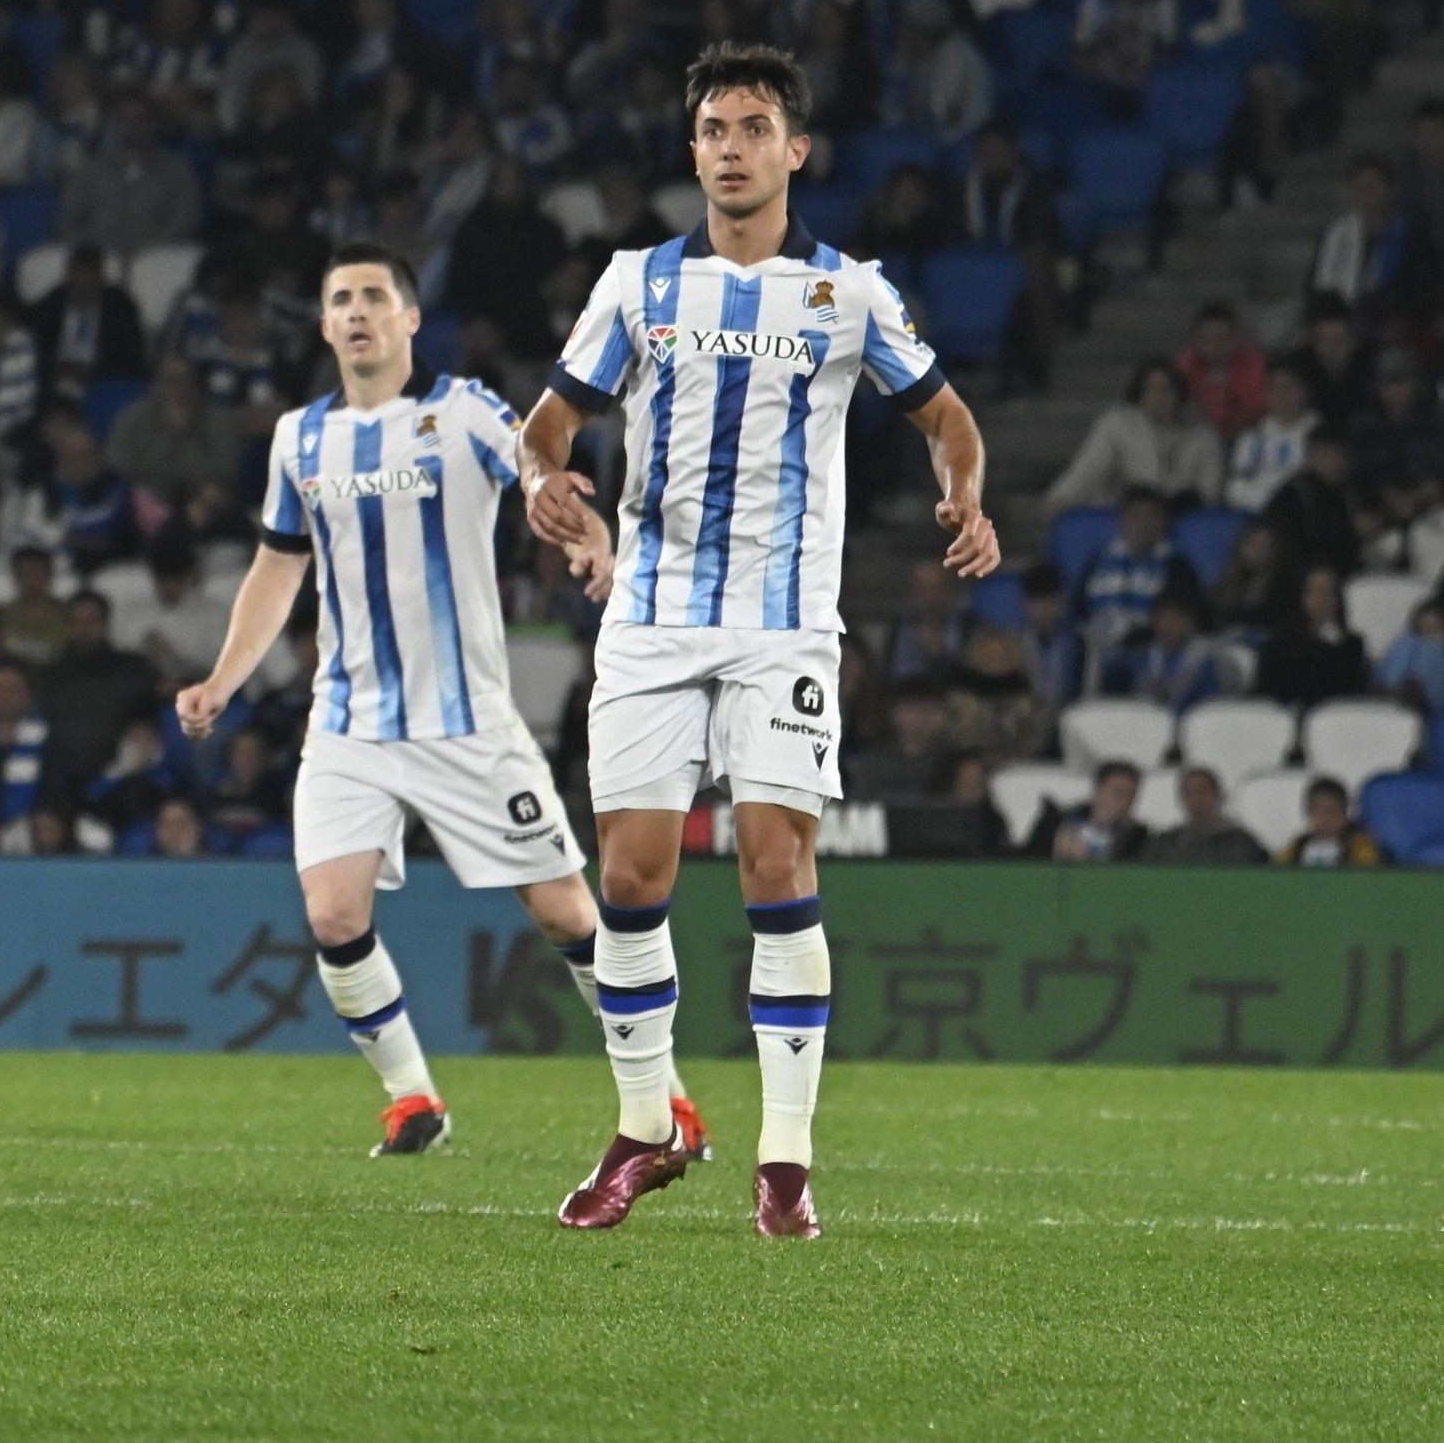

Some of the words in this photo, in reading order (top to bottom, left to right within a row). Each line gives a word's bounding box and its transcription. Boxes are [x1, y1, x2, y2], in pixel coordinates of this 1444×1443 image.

[690, 330, 815, 364] YASUDA
[331, 467, 435, 499] YASUDA
[769, 717, 833, 742] finetwork
